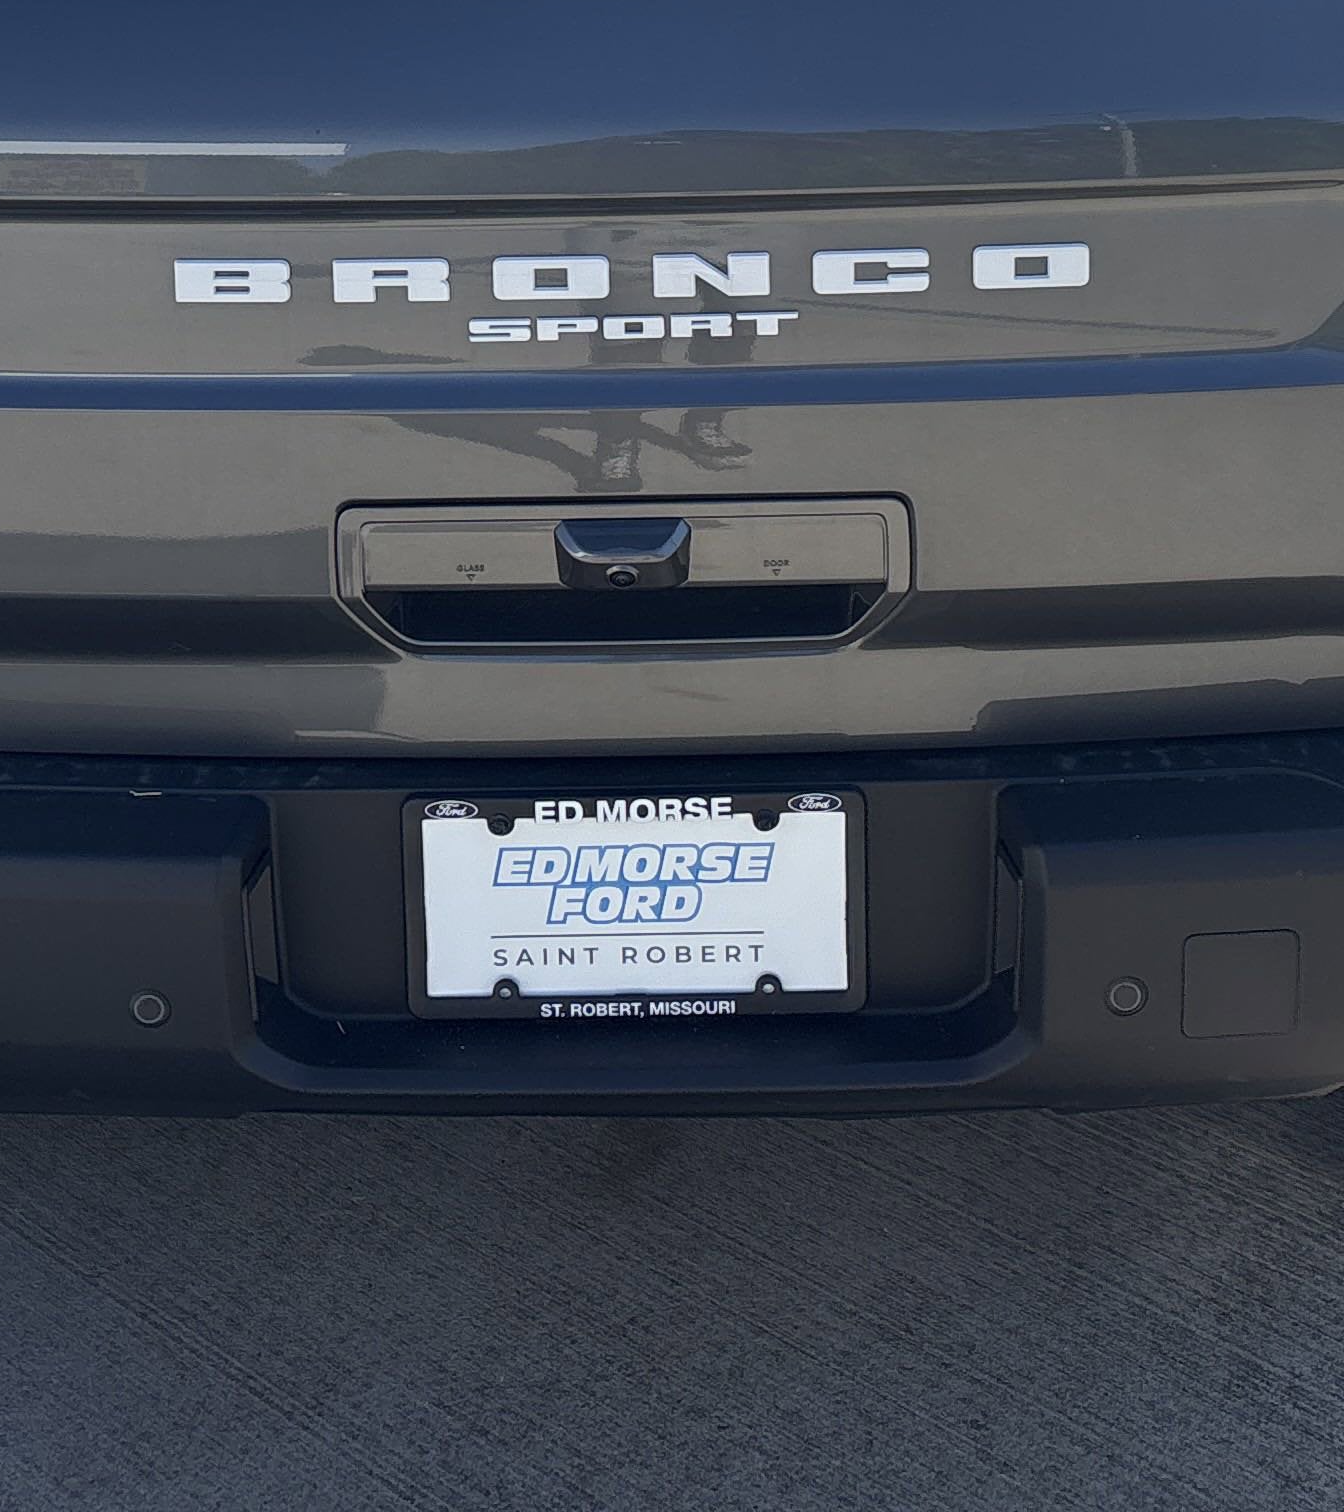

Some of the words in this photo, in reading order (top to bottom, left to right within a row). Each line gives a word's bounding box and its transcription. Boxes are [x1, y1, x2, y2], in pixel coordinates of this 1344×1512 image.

[172, 241, 1091, 304] BRONCO
[467, 310, 801, 344] SPORT
[456, 564, 485, 572] GLASS
[763, 559, 791, 568] DOOR
[435, 803, 467, 817] Ford
[534, 800, 584, 824] ED
[596, 796, 733, 824] MORSE
[798, 796, 831, 810] Ford
[546, 885, 703, 925] FORD
[493, 947, 600, 967] SAINT
[622, 944, 766, 965] ROBERT
[540, 1003, 566, 1018] ST.
[570, 1002, 646, 1018] ROBERT,
[649, 1000, 737, 1017] MISSOURI
